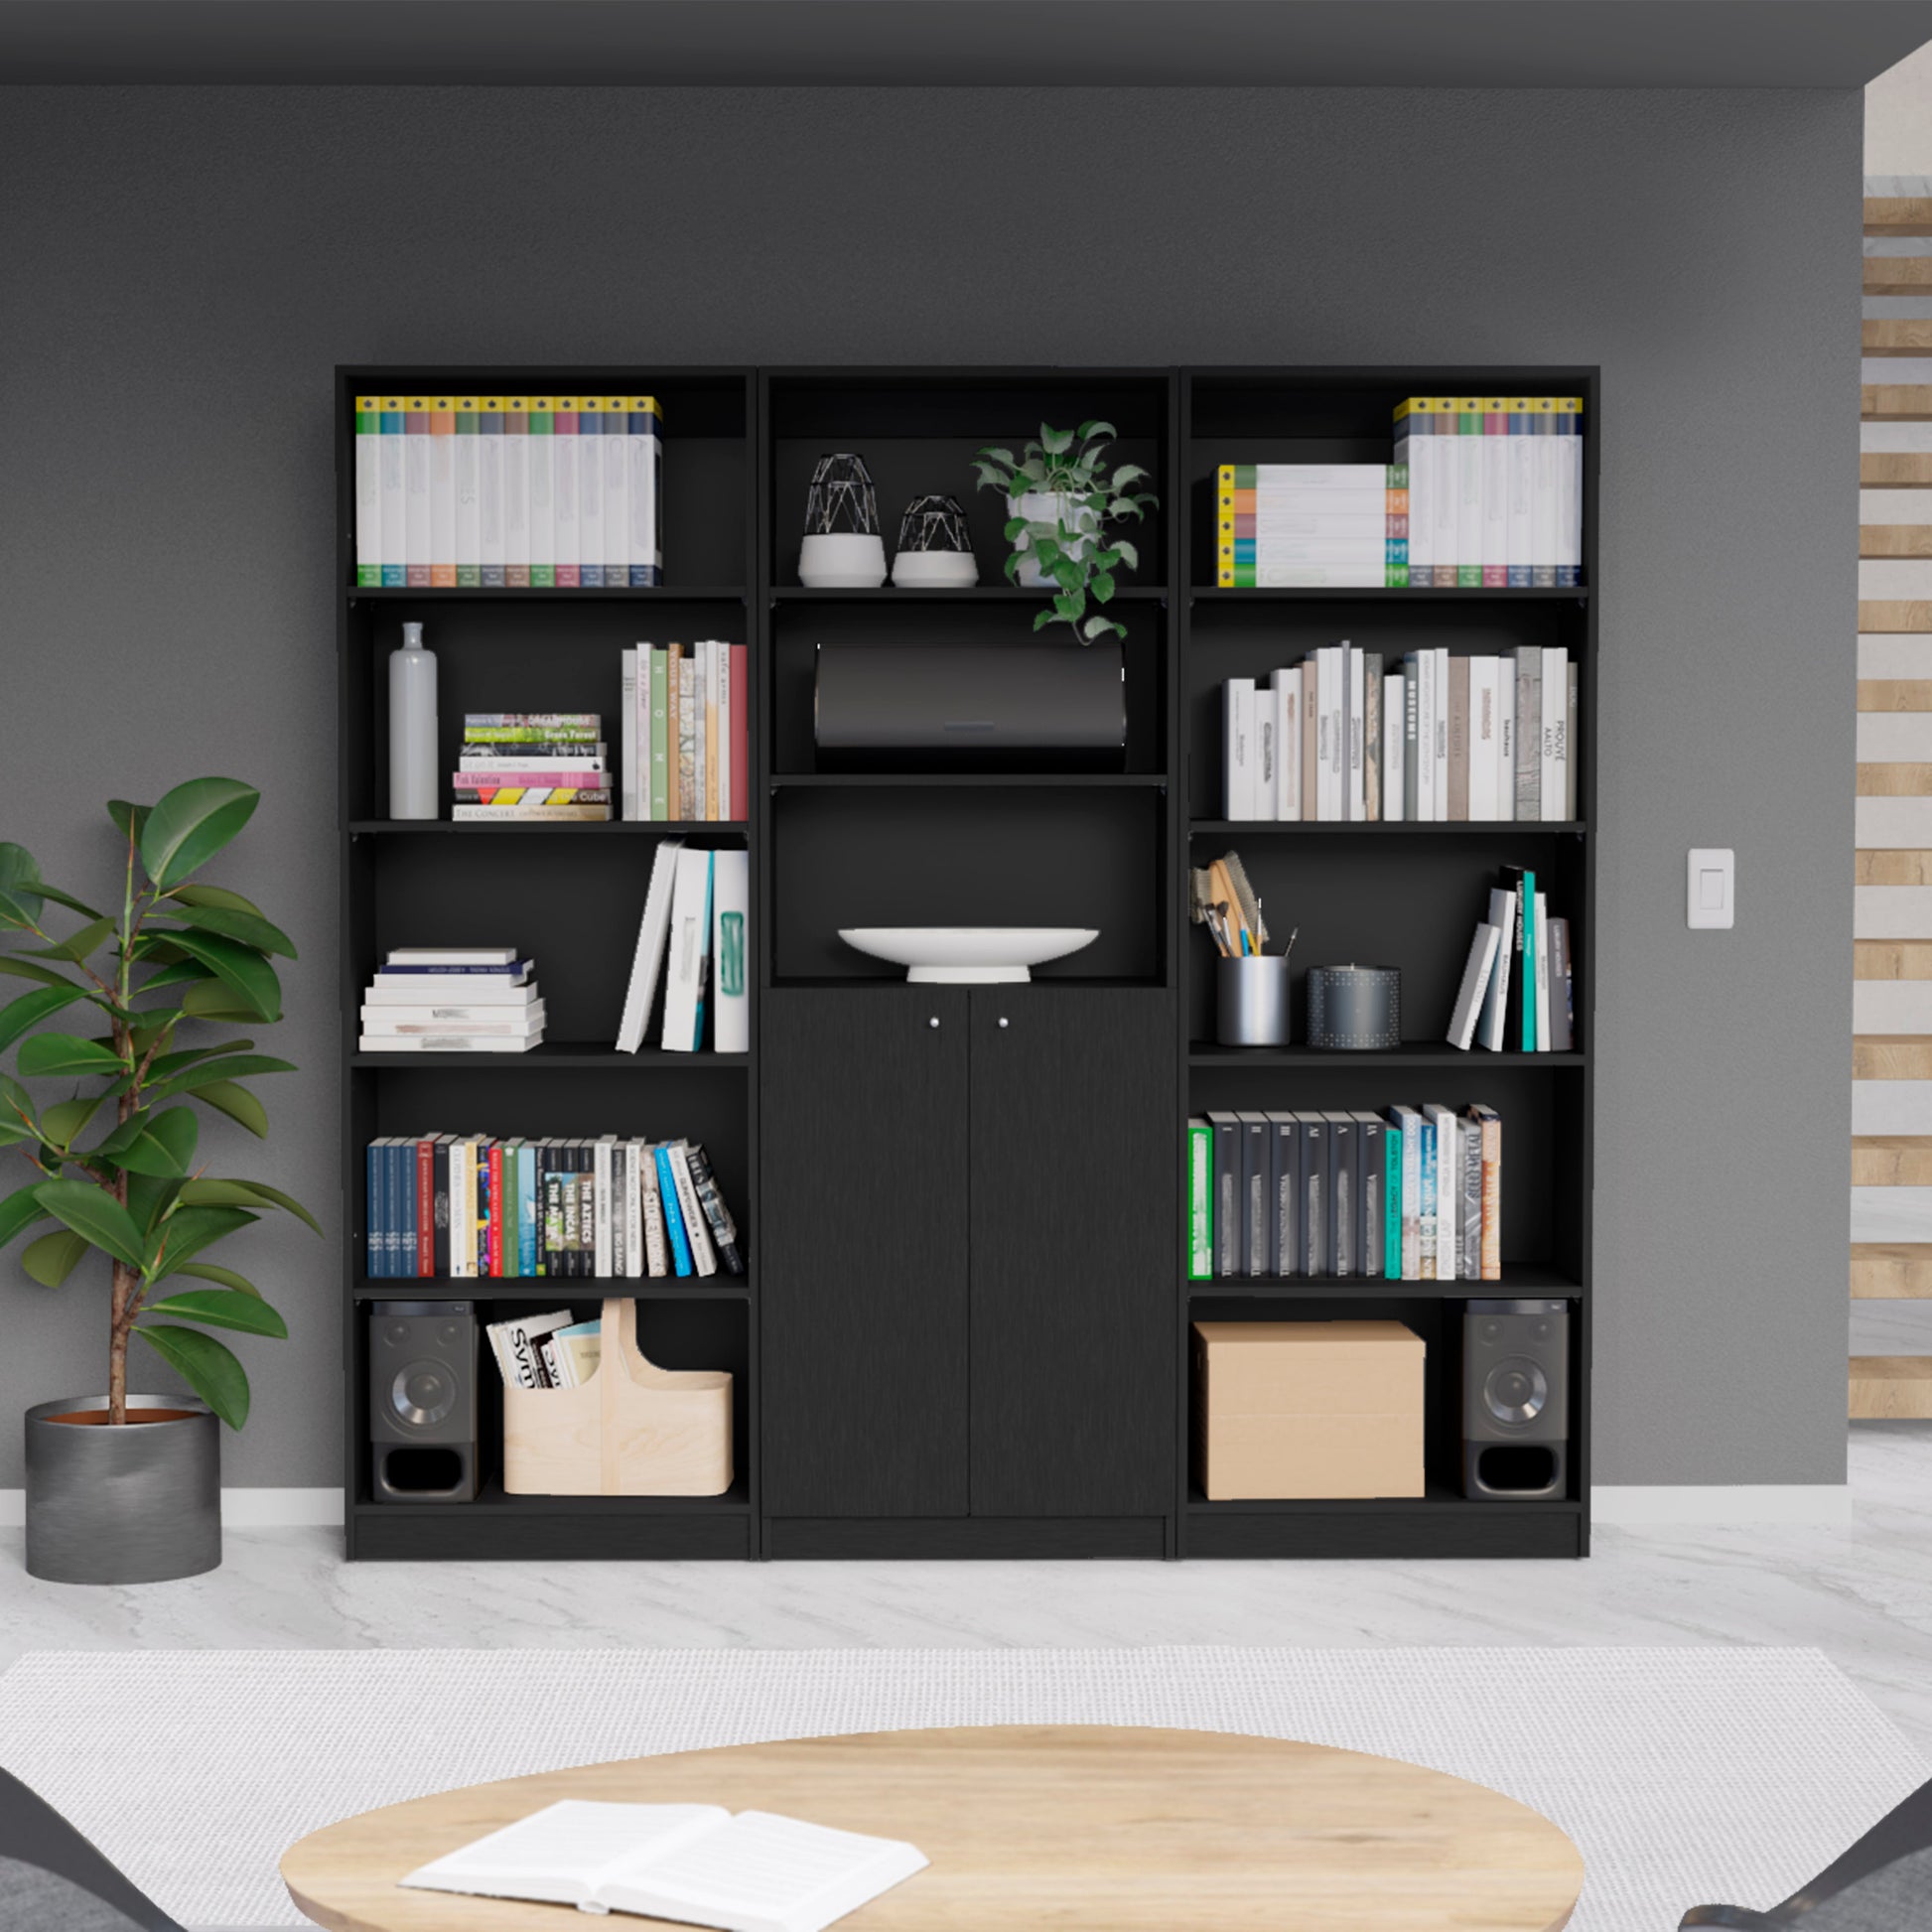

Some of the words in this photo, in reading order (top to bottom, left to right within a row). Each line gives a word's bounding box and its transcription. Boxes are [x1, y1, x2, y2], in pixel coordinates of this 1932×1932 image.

[1544, 727, 1553, 757] AALTO
[580, 791, 606, 802] Cube
[549, 1182, 559, 1203] THE
[565, 1182, 576, 1203] THE
[582, 1180, 592, 1201] THE
[549, 1205, 559, 1240] MAYA
[565, 1205, 576, 1240] INCAS
[582, 1203, 592, 1244] AZTECS
